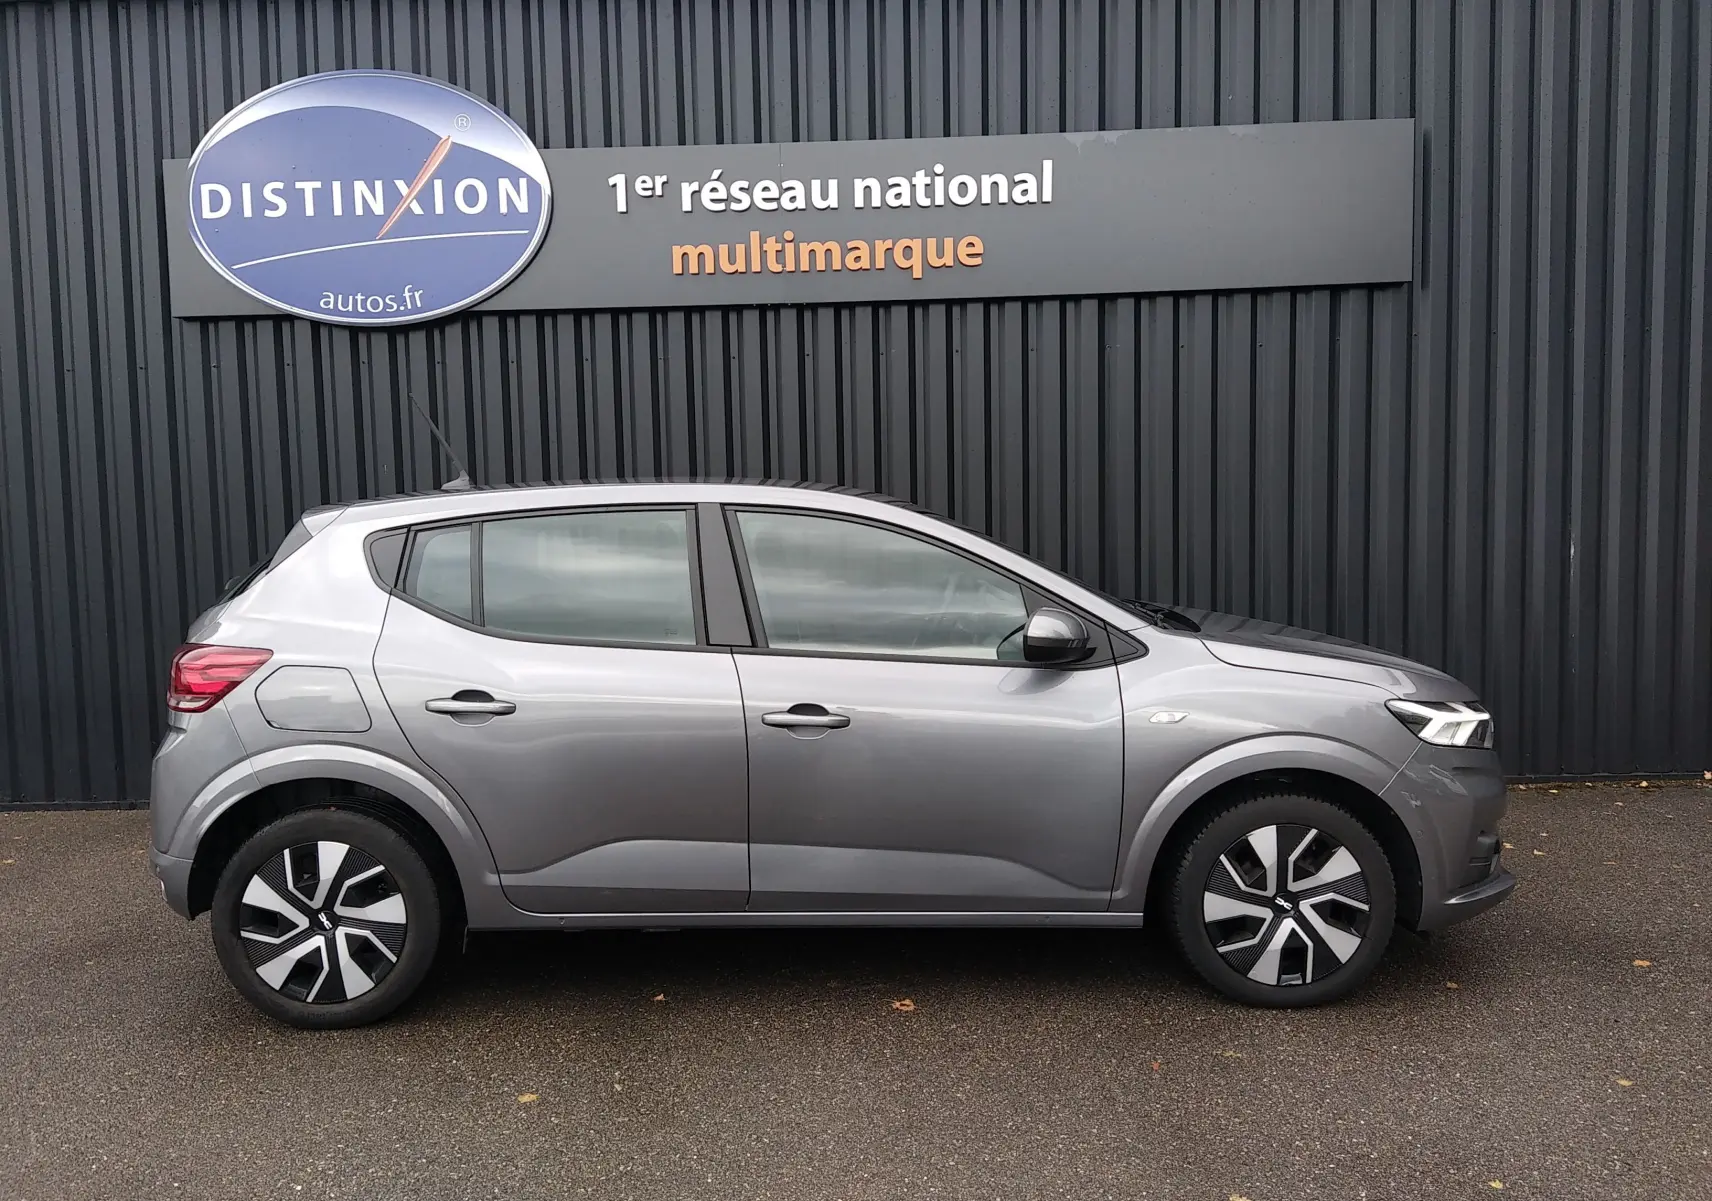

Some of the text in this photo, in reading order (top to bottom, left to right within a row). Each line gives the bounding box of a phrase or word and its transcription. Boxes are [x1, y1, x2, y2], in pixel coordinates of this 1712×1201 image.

[200, 177, 529, 219] DISTINXION
[607, 159, 1053, 213] 1er réseau national
[671, 231, 984, 278] multimarque
[319, 284, 423, 313] autos.fr
